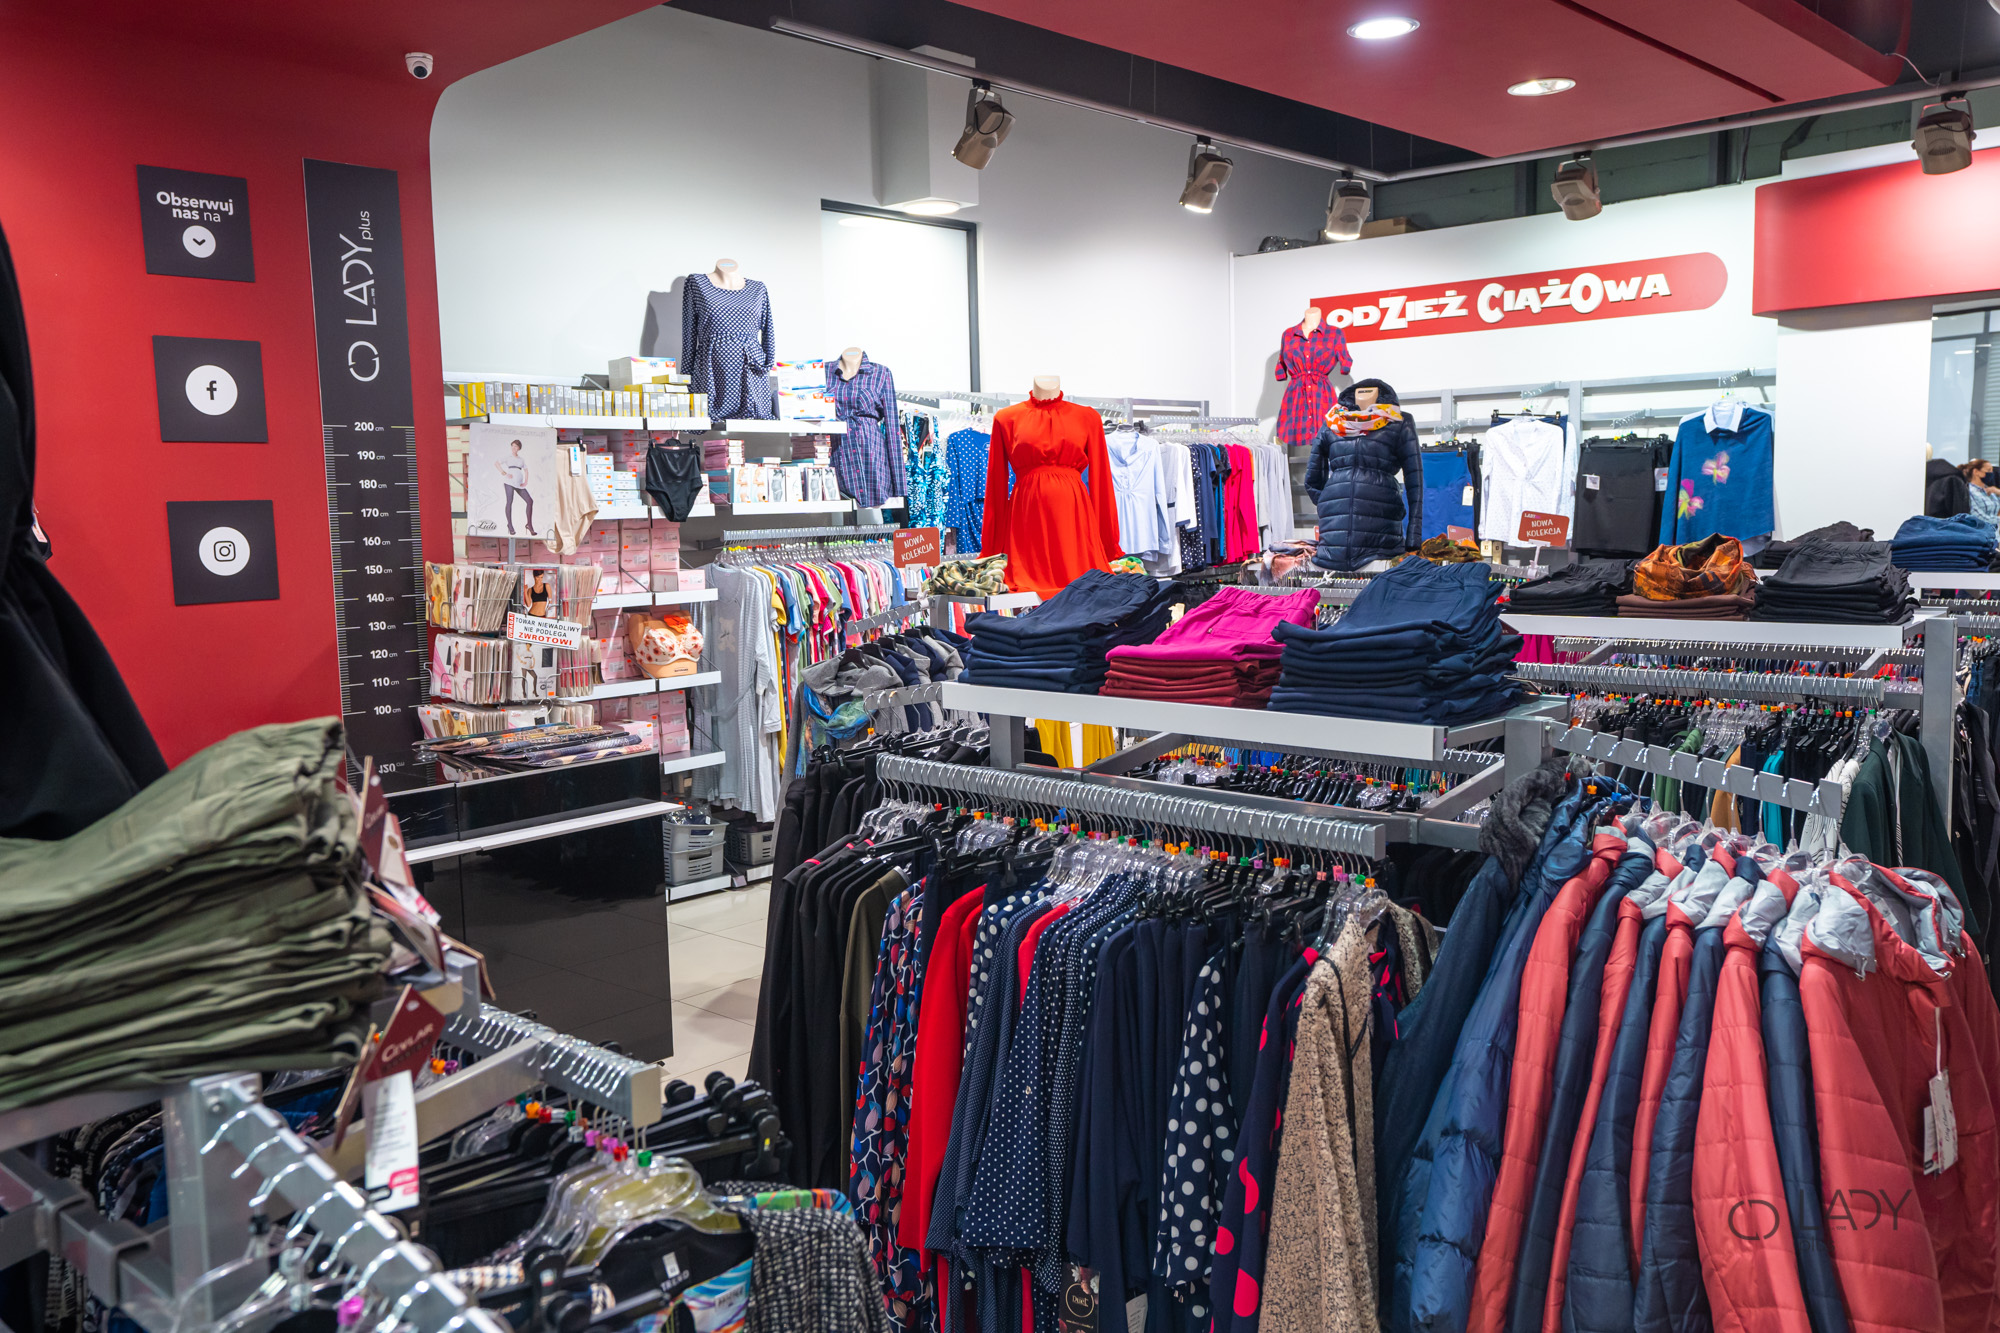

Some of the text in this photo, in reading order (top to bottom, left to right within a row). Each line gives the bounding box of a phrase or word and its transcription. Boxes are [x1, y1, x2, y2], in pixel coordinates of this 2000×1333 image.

[156, 191, 234, 215] Obserwuj
[172, 207, 221, 222] nas na
[358, 210, 374, 241] plus
[339, 233, 378, 326] LADY
[1326, 272, 1672, 331] ODZIEŻ CIĄŻOWA
[354, 422, 374, 432] 200
[357, 450, 376, 460] 190
[359, 480, 378, 489] 180
[361, 508, 379, 518] 170
[1531, 518, 1554, 528] NOWA
[1526, 528, 1562, 537] KOLEKCJA
[362, 536, 381, 546] 160
[904, 534, 925, 549] NOWA
[900, 542, 934, 562] KOLEKCJA
[364, 565, 383, 575] 150
[366, 593, 385, 603] 140
[368, 621, 386, 631] 130
[516, 618, 580, 632] TOWAR NIEWADLIWY
[536, 628, 567, 638] PODLEGA
[518, 632, 572, 646] ZWROTOWI
[370, 649, 388, 659] 120
[372, 677, 390, 687] 110
[374, 705, 392, 715] 100
